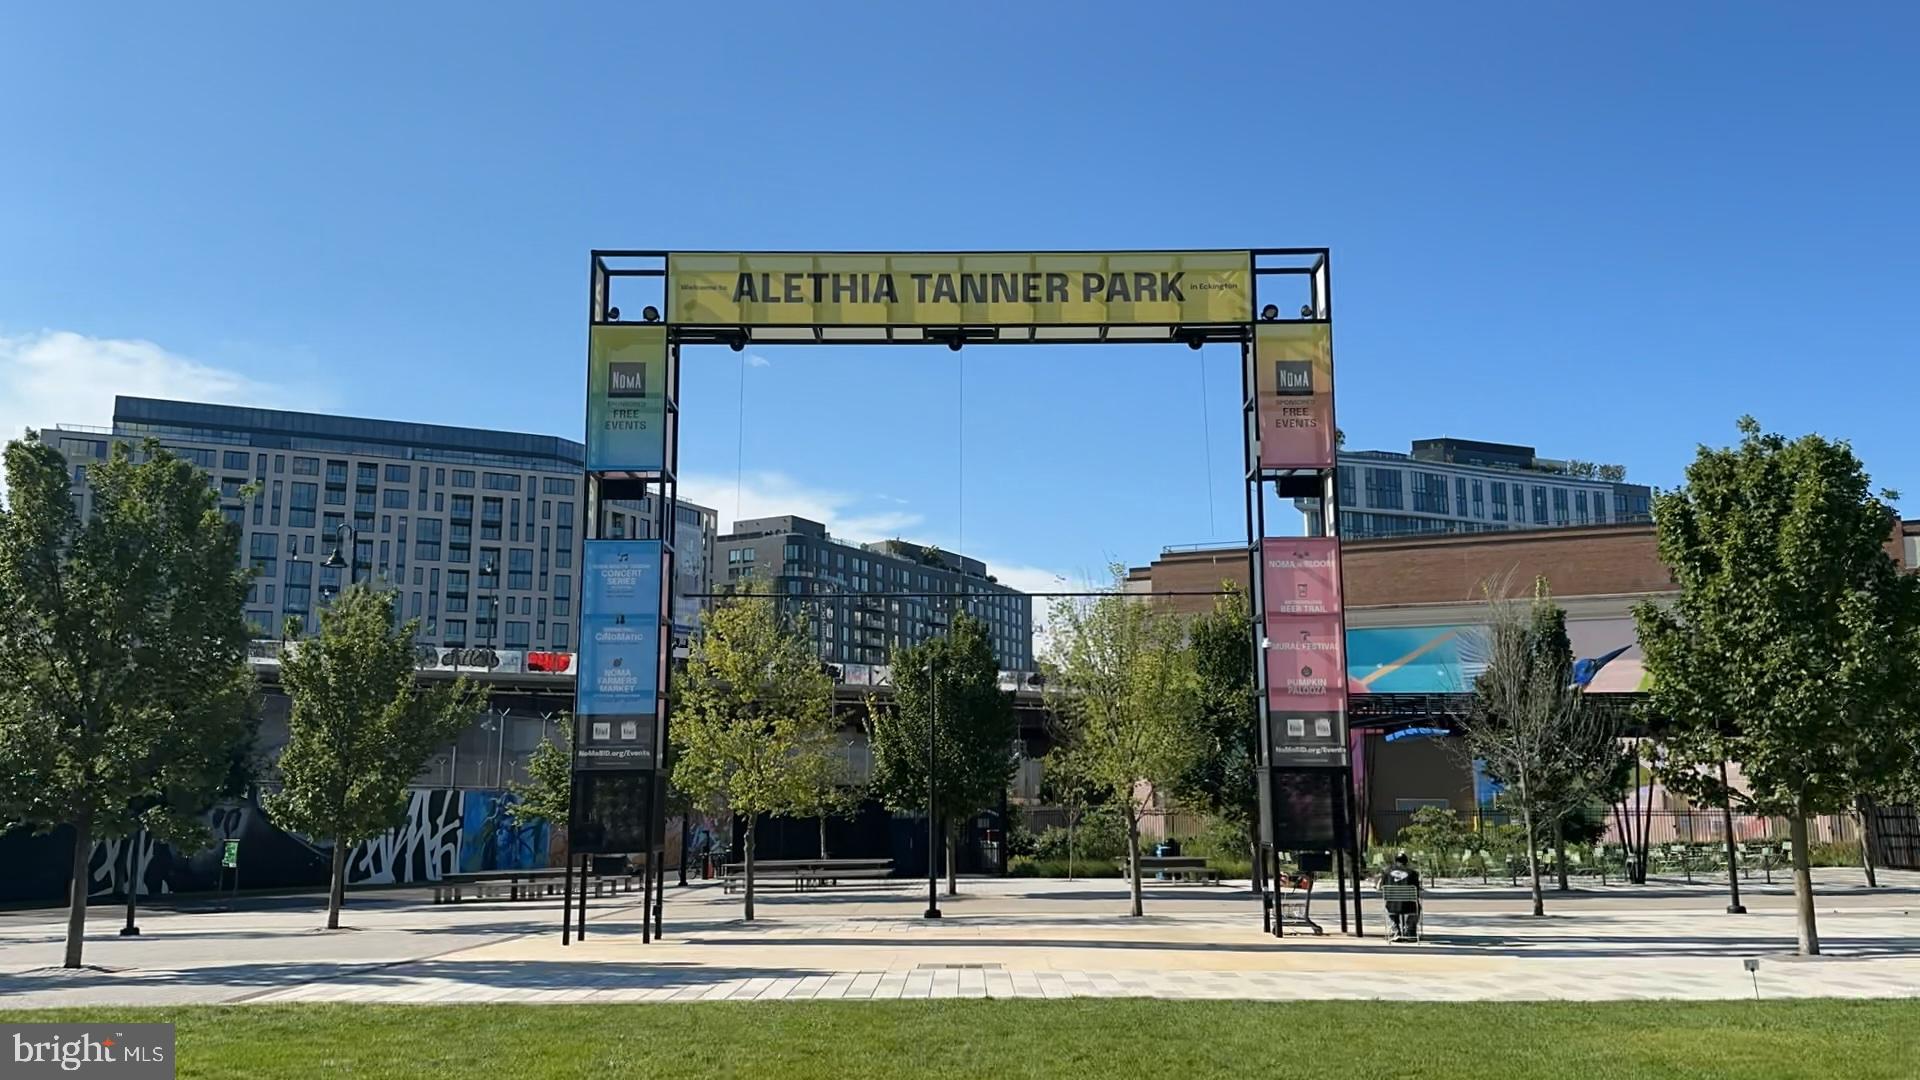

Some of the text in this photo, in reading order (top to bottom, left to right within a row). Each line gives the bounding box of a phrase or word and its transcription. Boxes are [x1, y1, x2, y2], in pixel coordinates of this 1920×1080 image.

[732, 271, 1187, 304] ALETHIA TANNER PARK
[1199, 282, 1238, 291] Eckington
[613, 409, 640, 419] FREE
[1282, 407, 1309, 417] FREE
[604, 420, 647, 430] EVENTS
[1275, 418, 1317, 428] EVENTS
[601, 569, 642, 578] CONCERT
[606, 578, 637, 586] SERIES
[1280, 605, 1328, 613] BEER TRAIL
[1302, 642, 1340, 650] FESTIVAL
[597, 677, 638, 685] FARMERS
[1287, 678, 1327, 687] PUMPKIN
[599, 685, 636, 693] MARKET
[1288, 687, 1327, 695] PALOOZA
